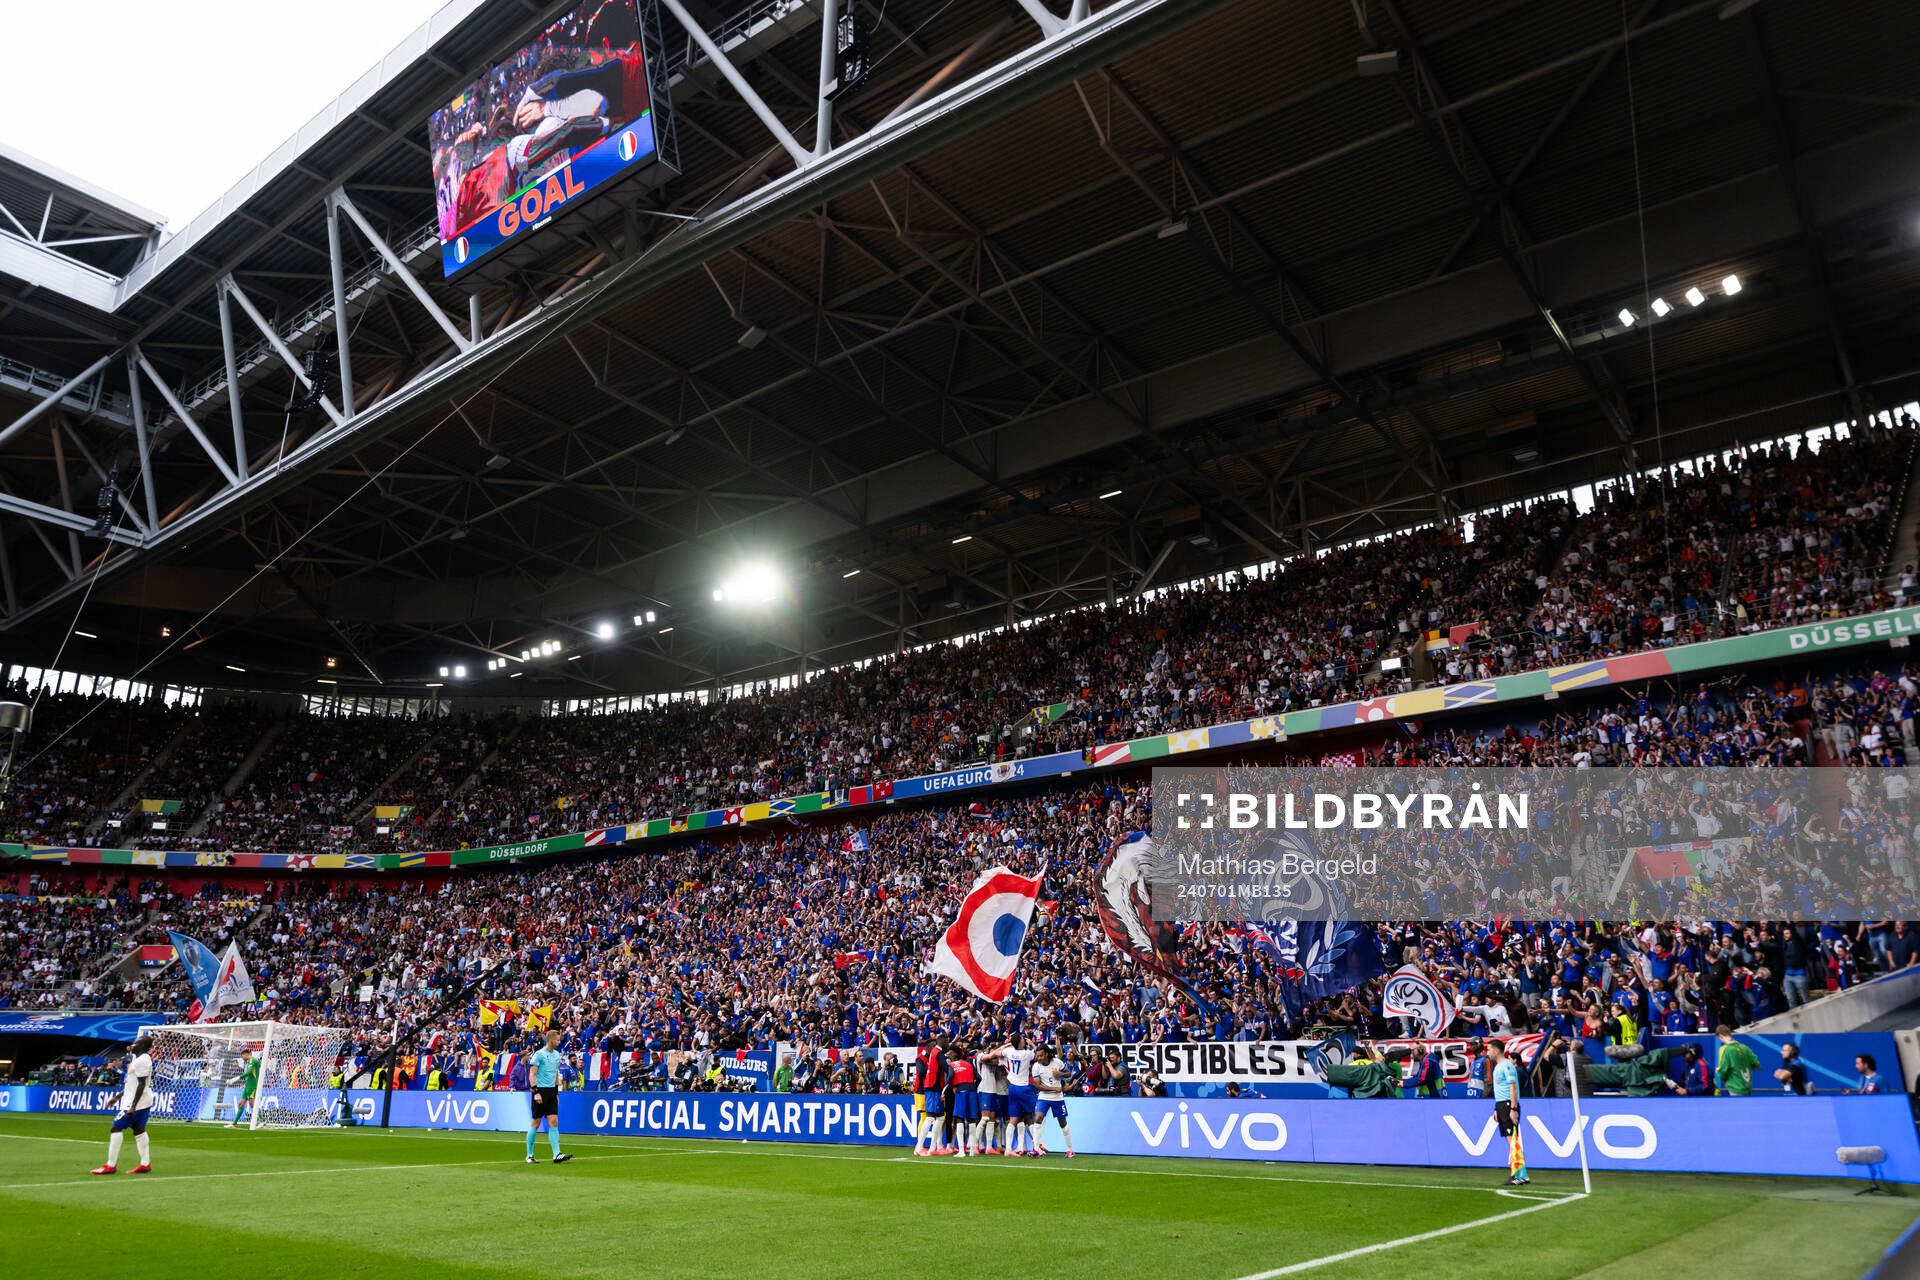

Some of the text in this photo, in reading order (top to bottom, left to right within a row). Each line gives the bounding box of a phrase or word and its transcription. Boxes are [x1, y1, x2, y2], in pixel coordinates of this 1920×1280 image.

[498, 166, 585, 236] GOAL
[490, 842, 548, 859] DÜSSELDORF
[1010, 1059, 1021, 1075] 17
[1080, 1044, 1286, 1076] ESISTIBLES
[49, 1090, 92, 1110] OFFICIAL
[426, 1093, 491, 1125] vivo
[592, 1099, 936, 1139] OFFICIAL SMARTPHON
[1130, 1101, 1288, 1151] vivo
[1442, 1114, 1658, 1160] vvo
